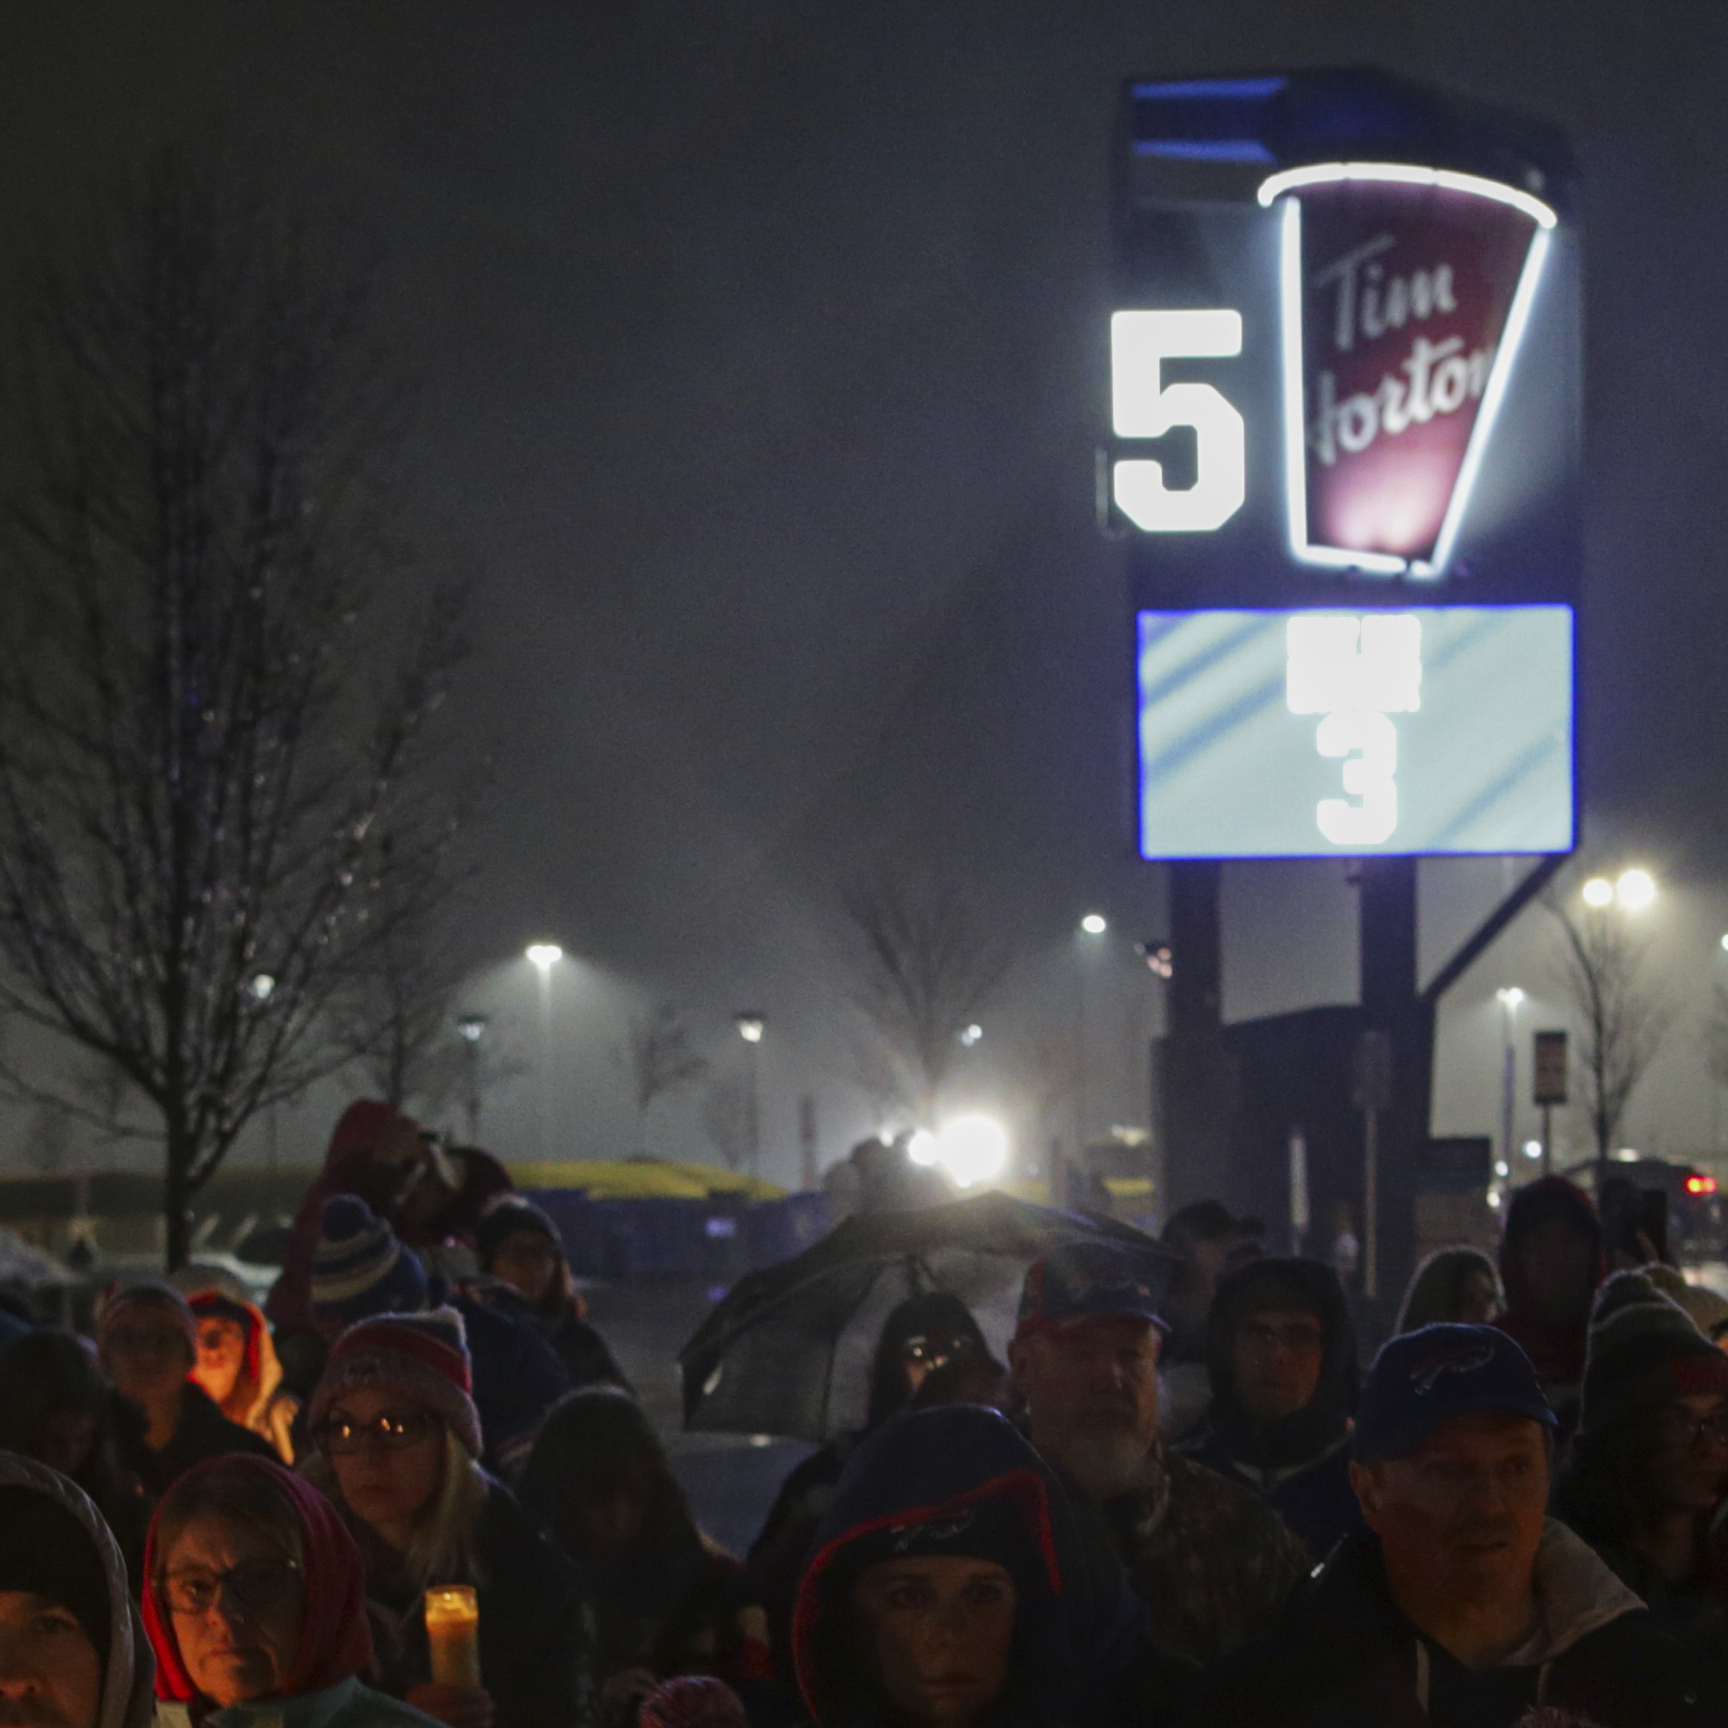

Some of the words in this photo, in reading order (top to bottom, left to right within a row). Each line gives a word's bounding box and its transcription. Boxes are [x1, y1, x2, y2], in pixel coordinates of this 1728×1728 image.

[1316, 233, 1458, 350] Tim
[1111, 309, 1245, 531] 5
[1315, 711, 1398, 845] 3
